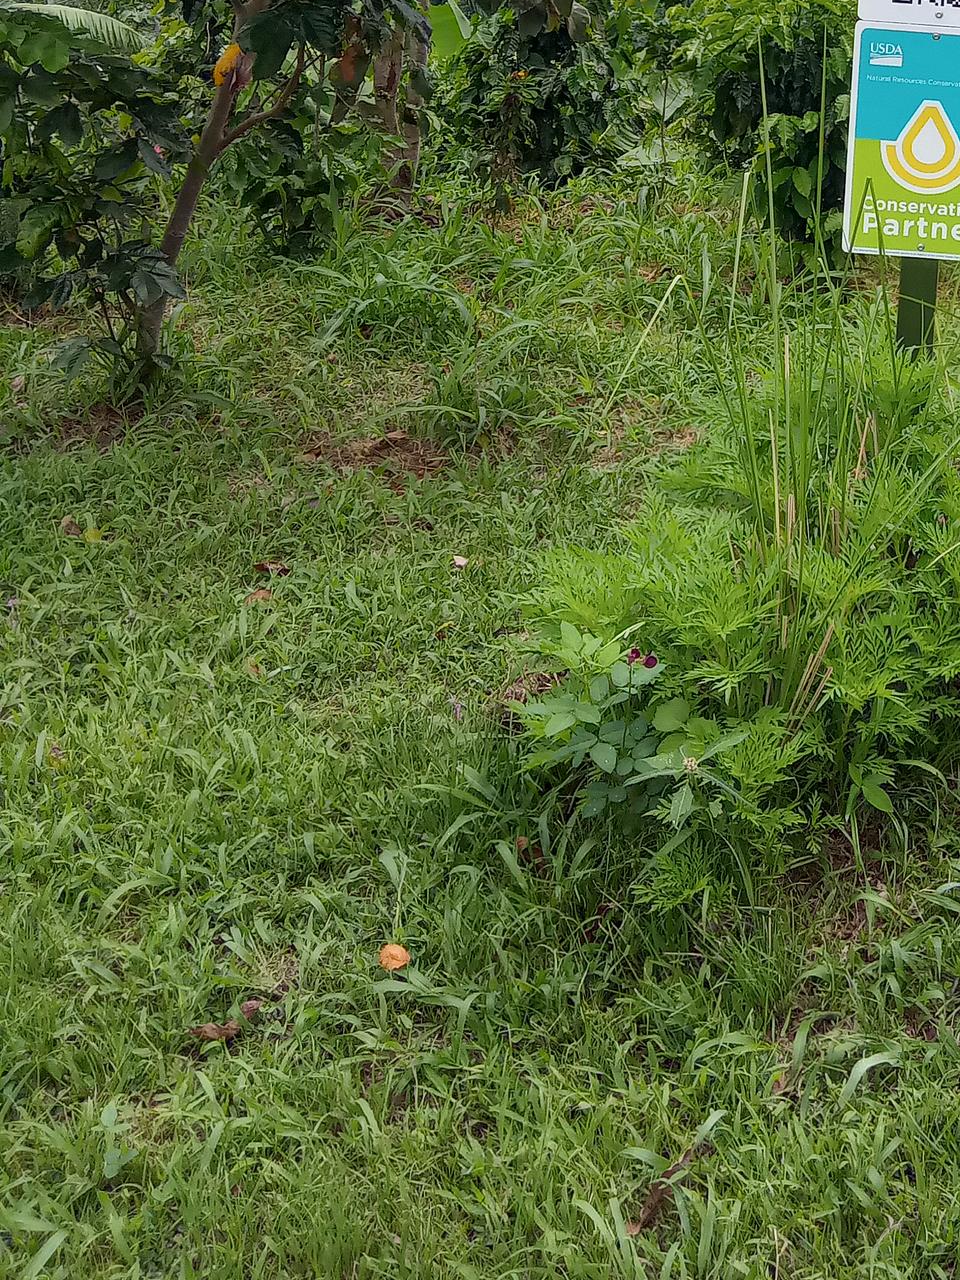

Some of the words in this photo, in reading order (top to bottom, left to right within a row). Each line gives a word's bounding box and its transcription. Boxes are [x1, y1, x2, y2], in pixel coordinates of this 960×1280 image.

[870, 42, 903, 55] USDA
[867, 74, 891, 82] Natural
[892, 76, 927, 85] Resources
